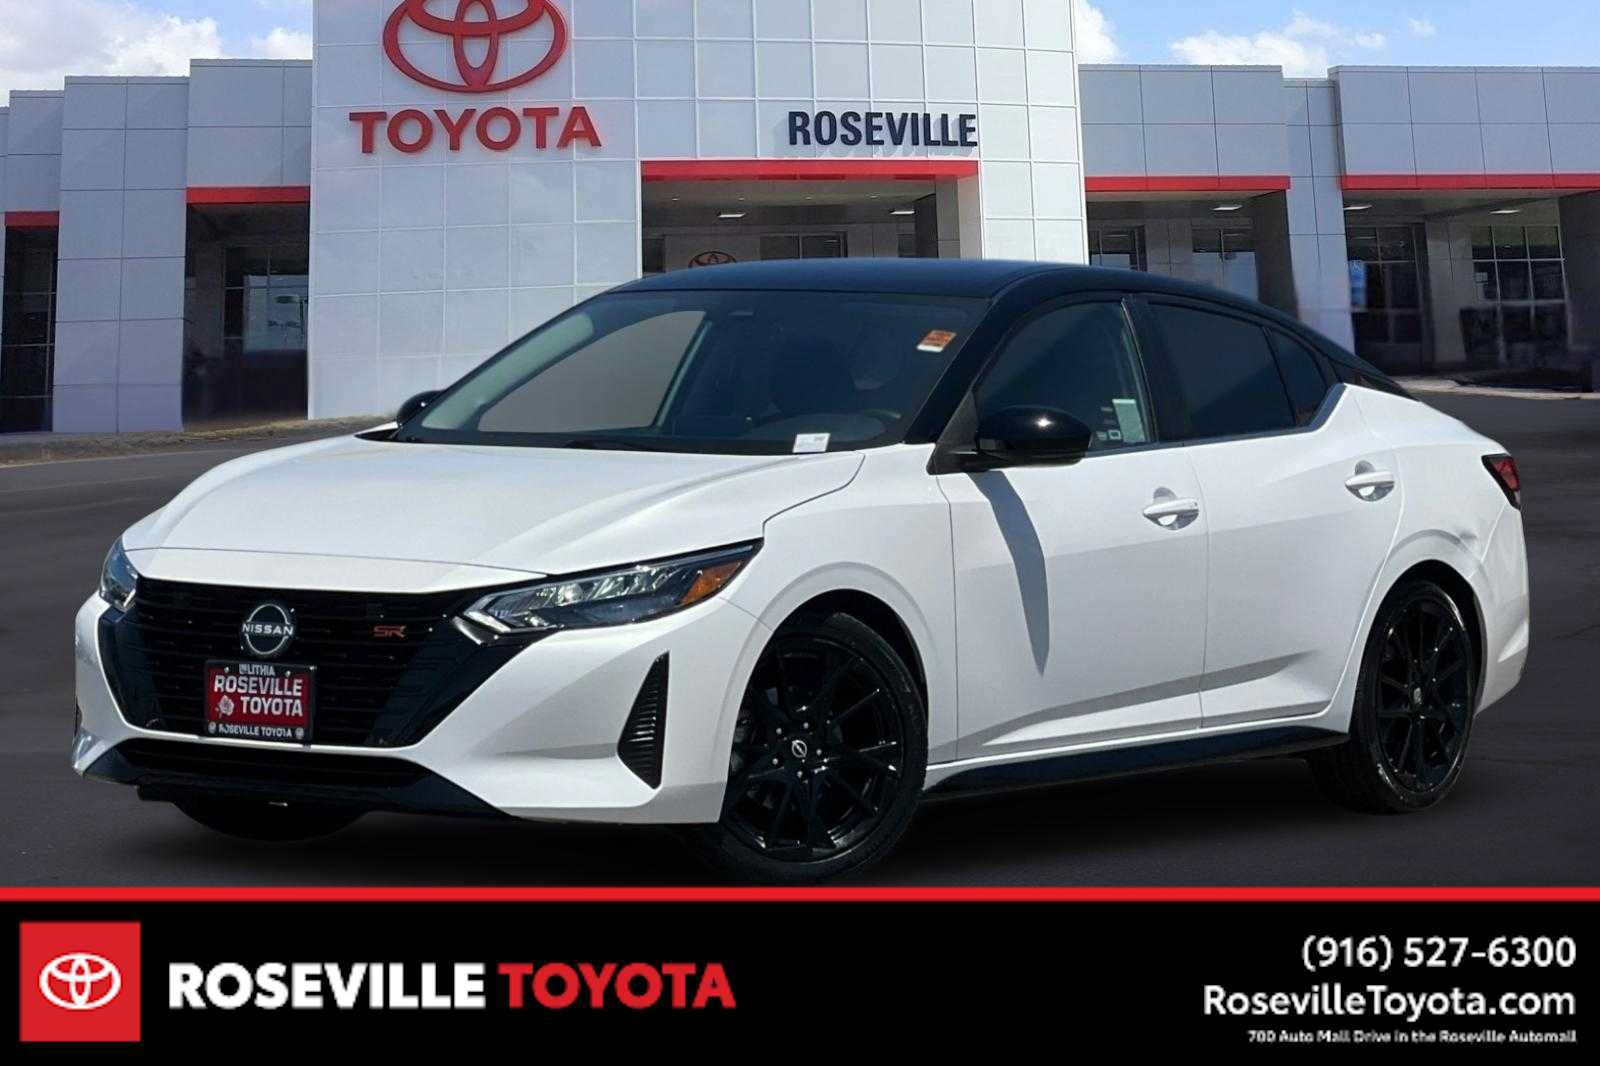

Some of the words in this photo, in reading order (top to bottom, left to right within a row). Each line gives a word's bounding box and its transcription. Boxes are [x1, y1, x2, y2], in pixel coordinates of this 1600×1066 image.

[349, 106, 602, 153] TOYOTA
[787, 110, 978, 147] ROSEVILLE
[242, 623, 294, 636] NISSAN
[373, 625, 407, 638] SR
[247, 664, 275, 676] LITHIA
[214, 675, 303, 696] ROSEVILLE
[240, 696, 303, 717] TOYOTA
[218, 723, 260, 736] ROSEVILLE
[261, 727, 292, 737] TOYOTA
